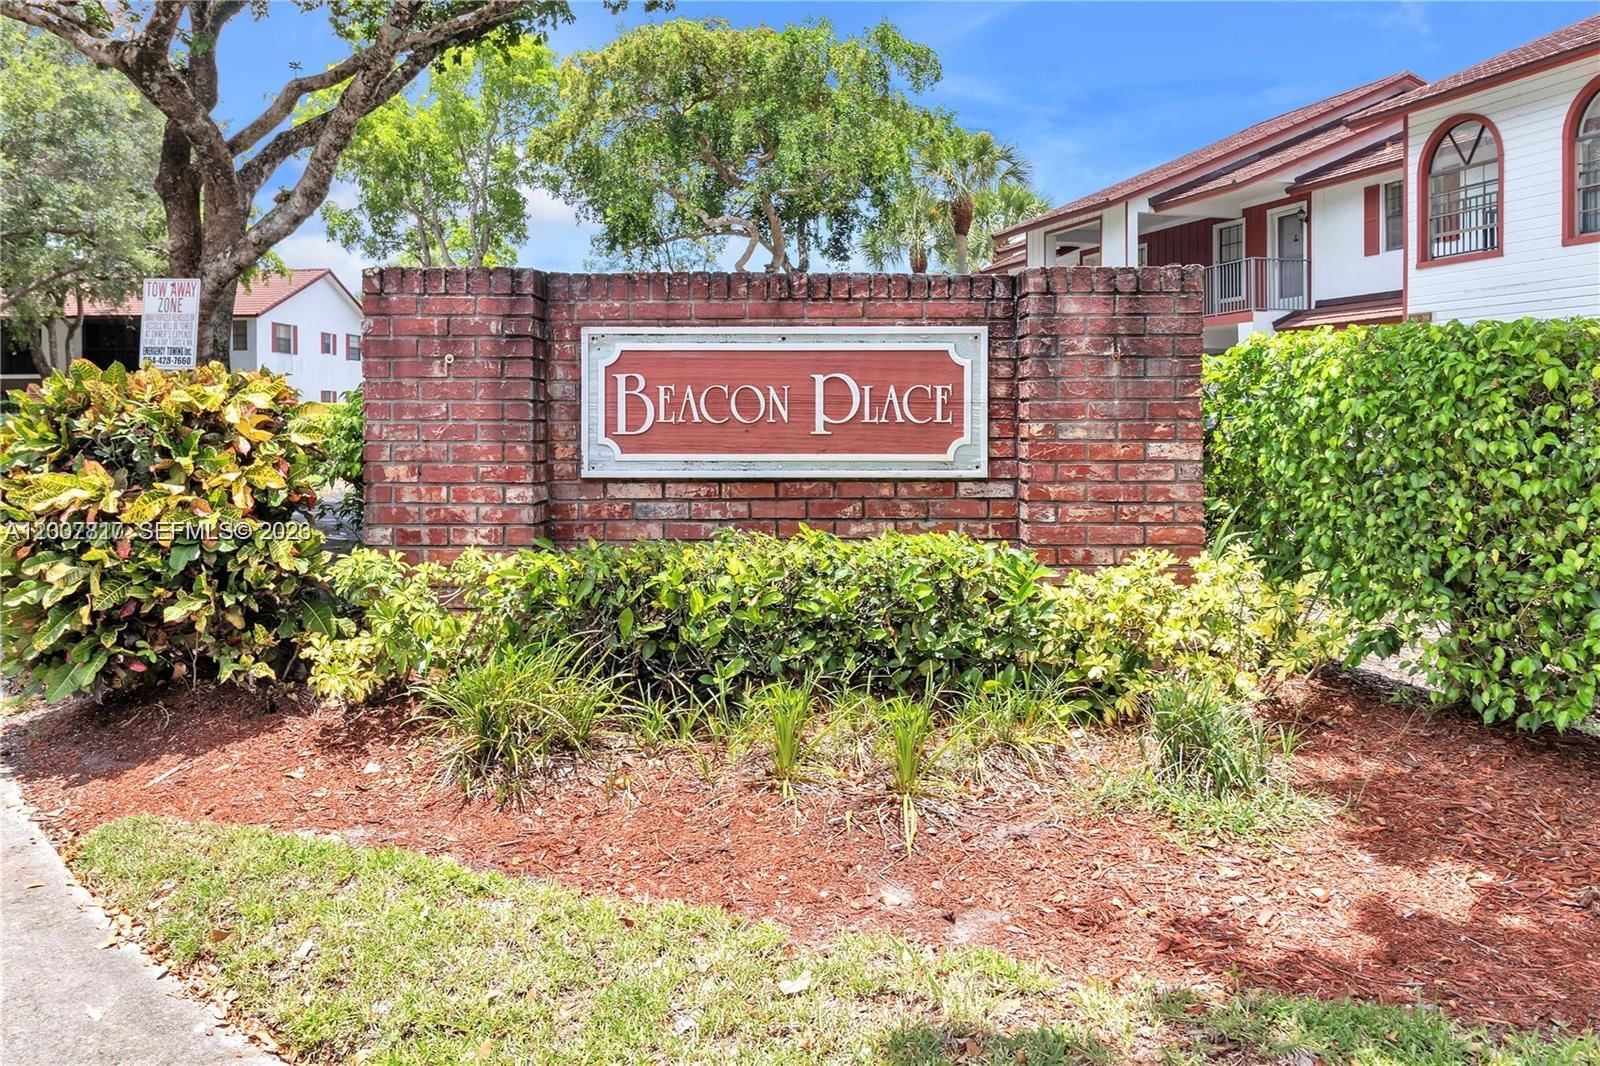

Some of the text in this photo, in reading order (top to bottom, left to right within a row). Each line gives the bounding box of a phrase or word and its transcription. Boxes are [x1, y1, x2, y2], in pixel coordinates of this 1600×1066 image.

[147, 282, 197, 297] TOW AWAY
[158, 298, 183, 313] ZONE
[143, 346, 166, 356] EMERGENCY
[167, 346, 184, 356] TOWING
[612, 373, 953, 436] BEACON PLACE
